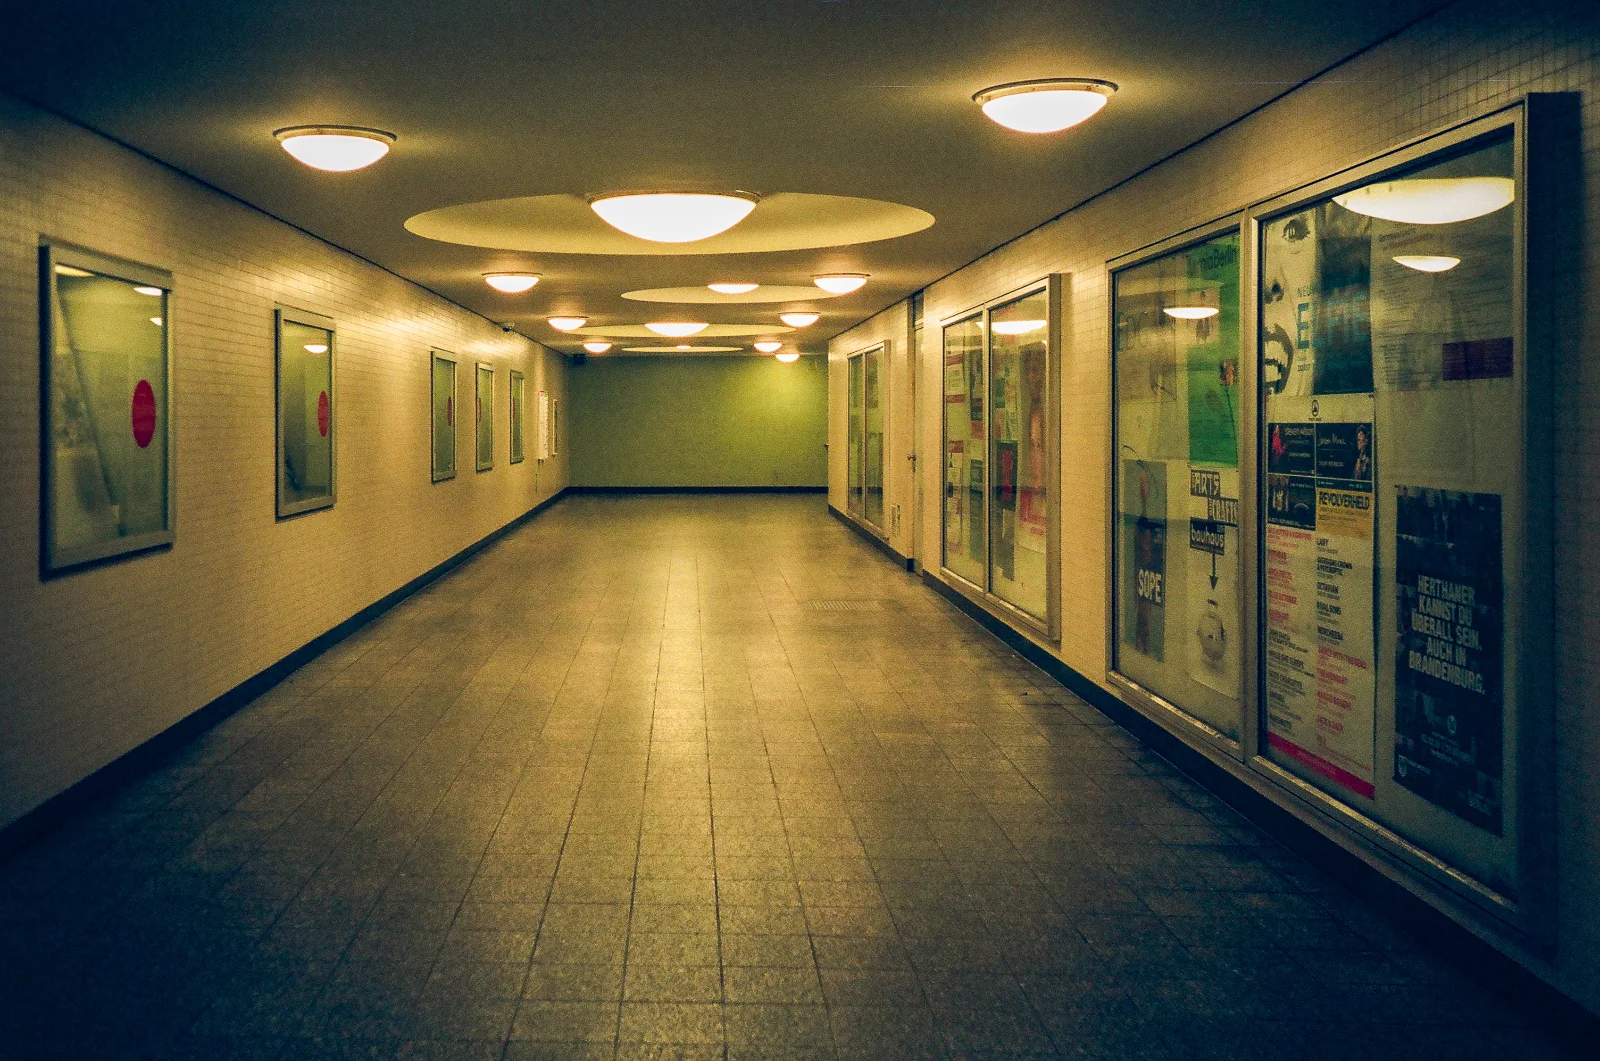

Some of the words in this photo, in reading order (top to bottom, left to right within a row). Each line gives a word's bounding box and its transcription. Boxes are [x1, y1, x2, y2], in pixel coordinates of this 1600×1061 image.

[1195, 472, 1220, 496] ARTS
[1319, 491, 1370, 510] REVOLVERHELD
[1191, 523, 1224, 548] bauhaus
[1137, 568, 1162, 603] SOPE
[1418, 574, 1475, 606] HERTHANER
[1411, 608, 1453, 643] ÜBERALL
[1419, 595, 1457, 622] KANNST
[1458, 605, 1472, 627] DU
[1426, 637, 1453, 662] AUCH
[1455, 645, 1467, 667] IN
[1409, 650, 1485, 695] BRANDENBURG.
